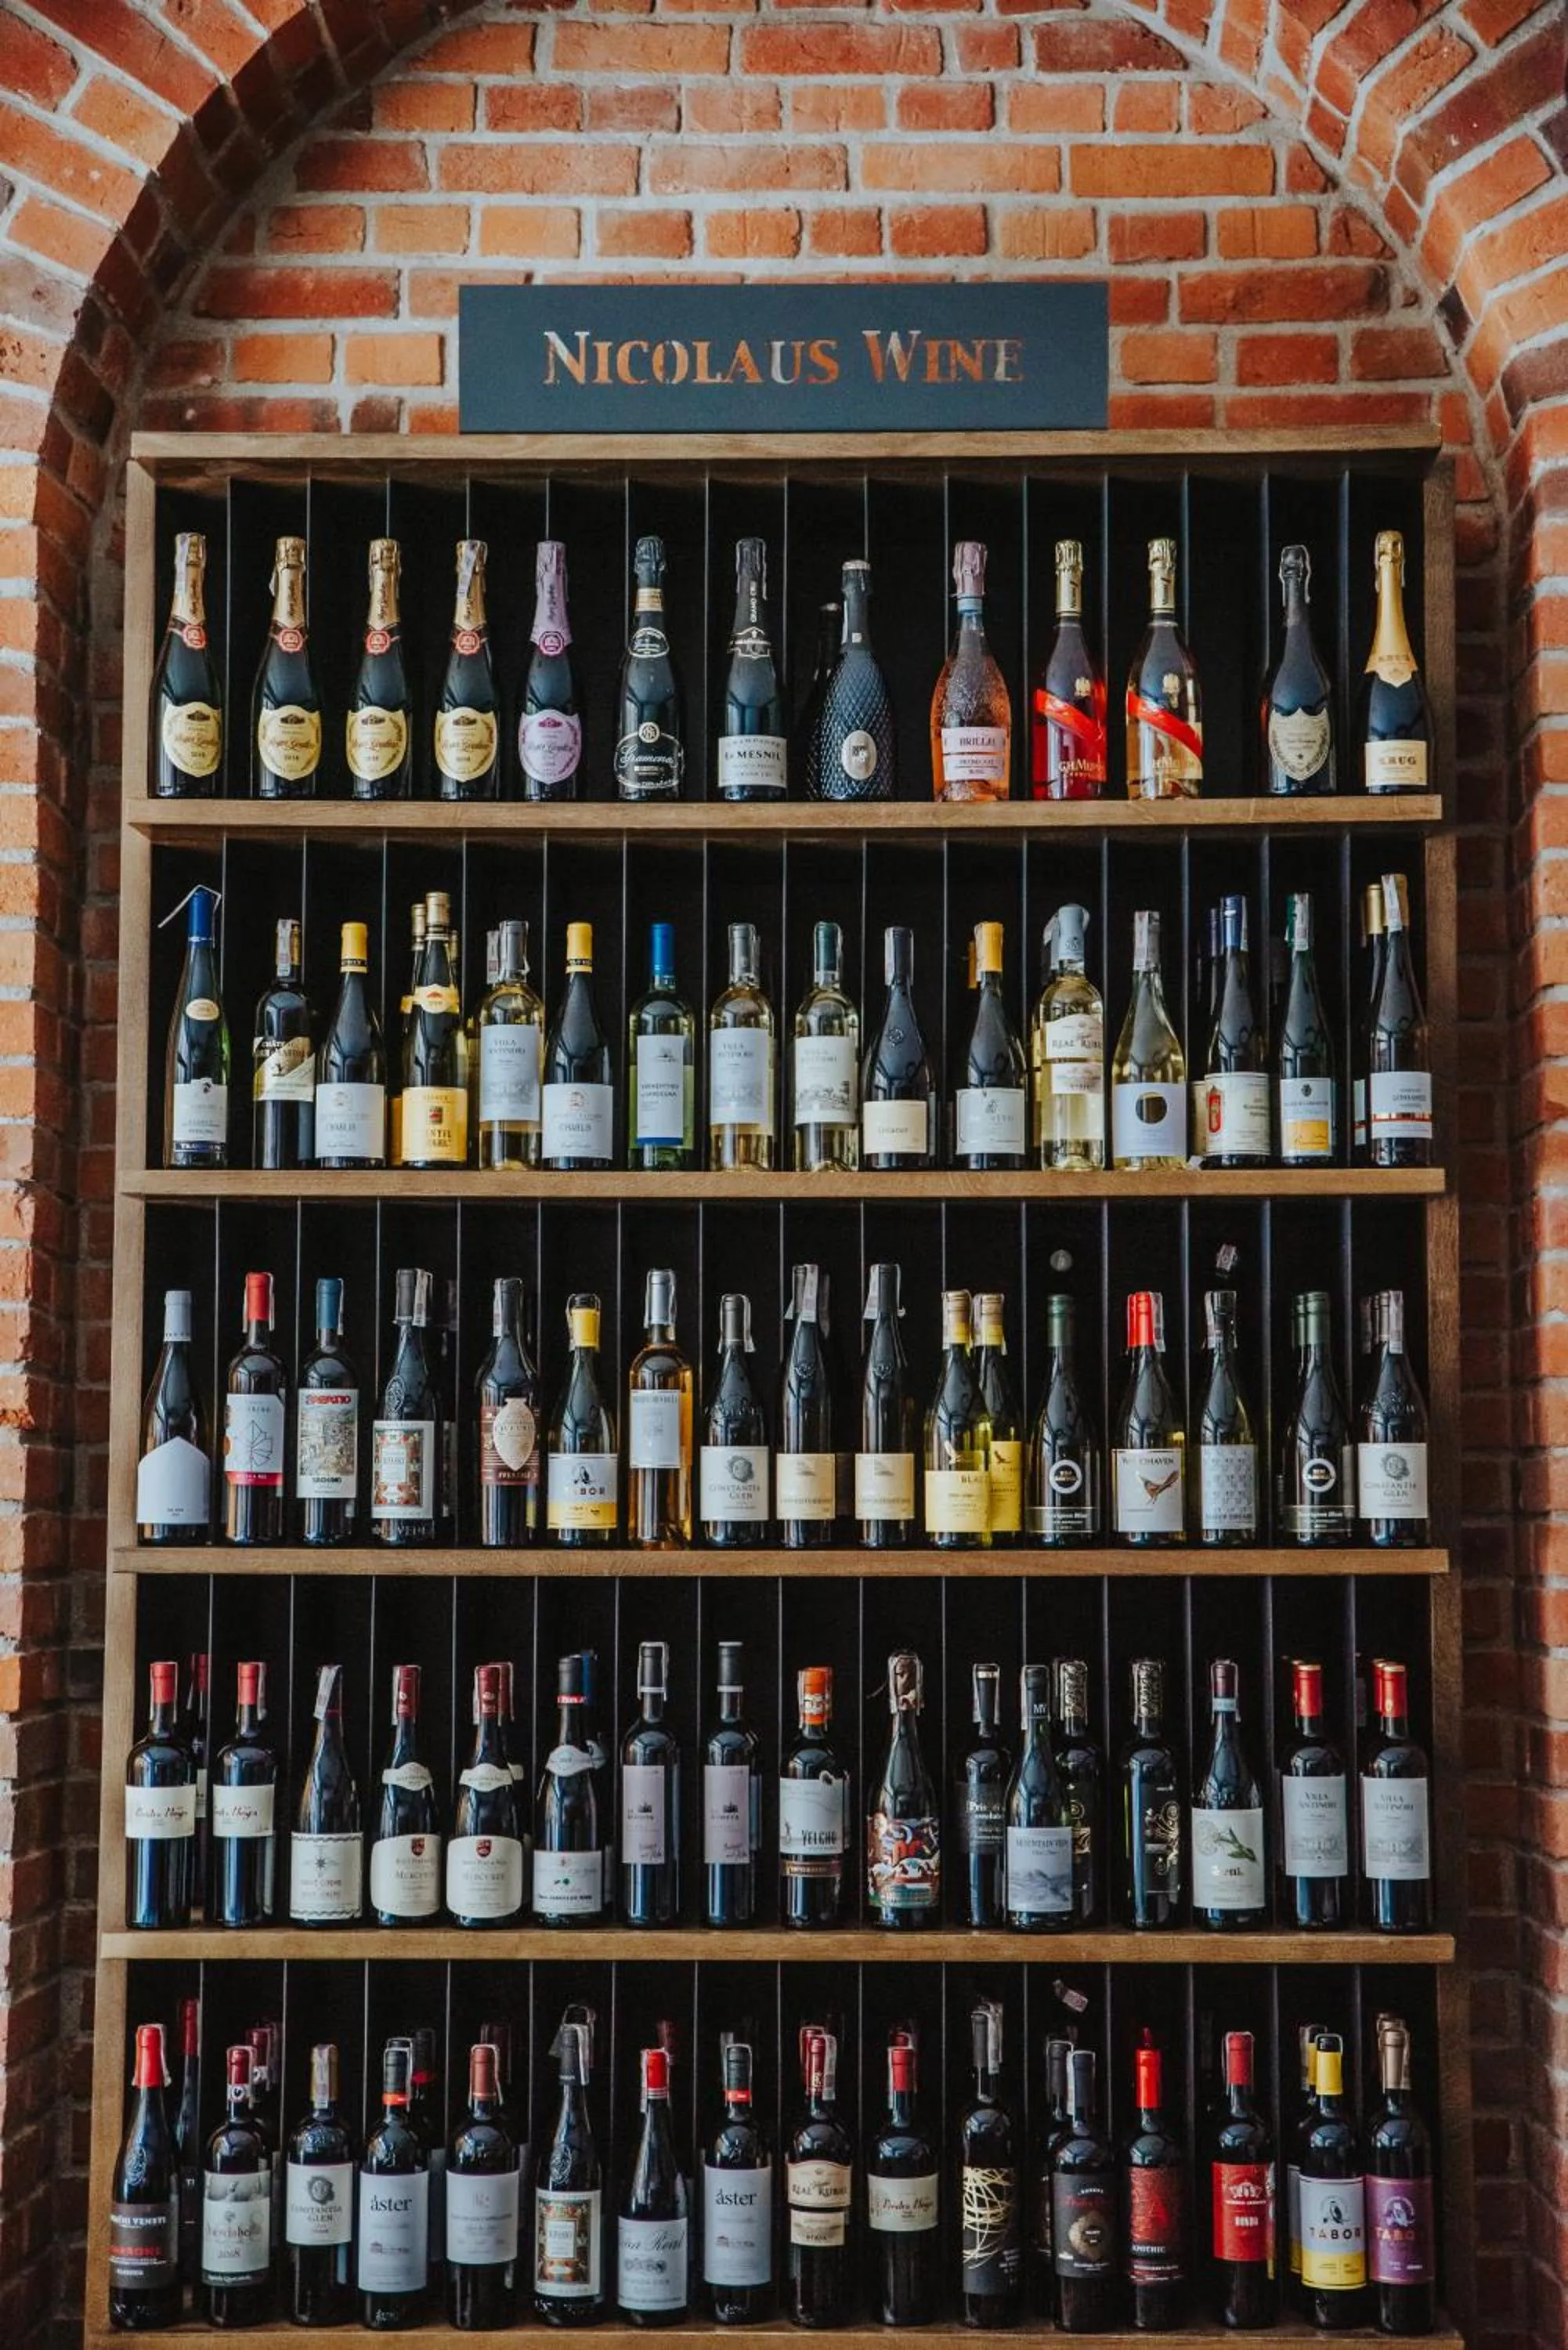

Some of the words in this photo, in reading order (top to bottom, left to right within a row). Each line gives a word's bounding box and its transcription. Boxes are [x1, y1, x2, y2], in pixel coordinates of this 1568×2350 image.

[543, 331, 839, 385] NICOLAUS
[862, 330, 1026, 383] WINE
[1308, 2226, 1361, 2240] TABOR
